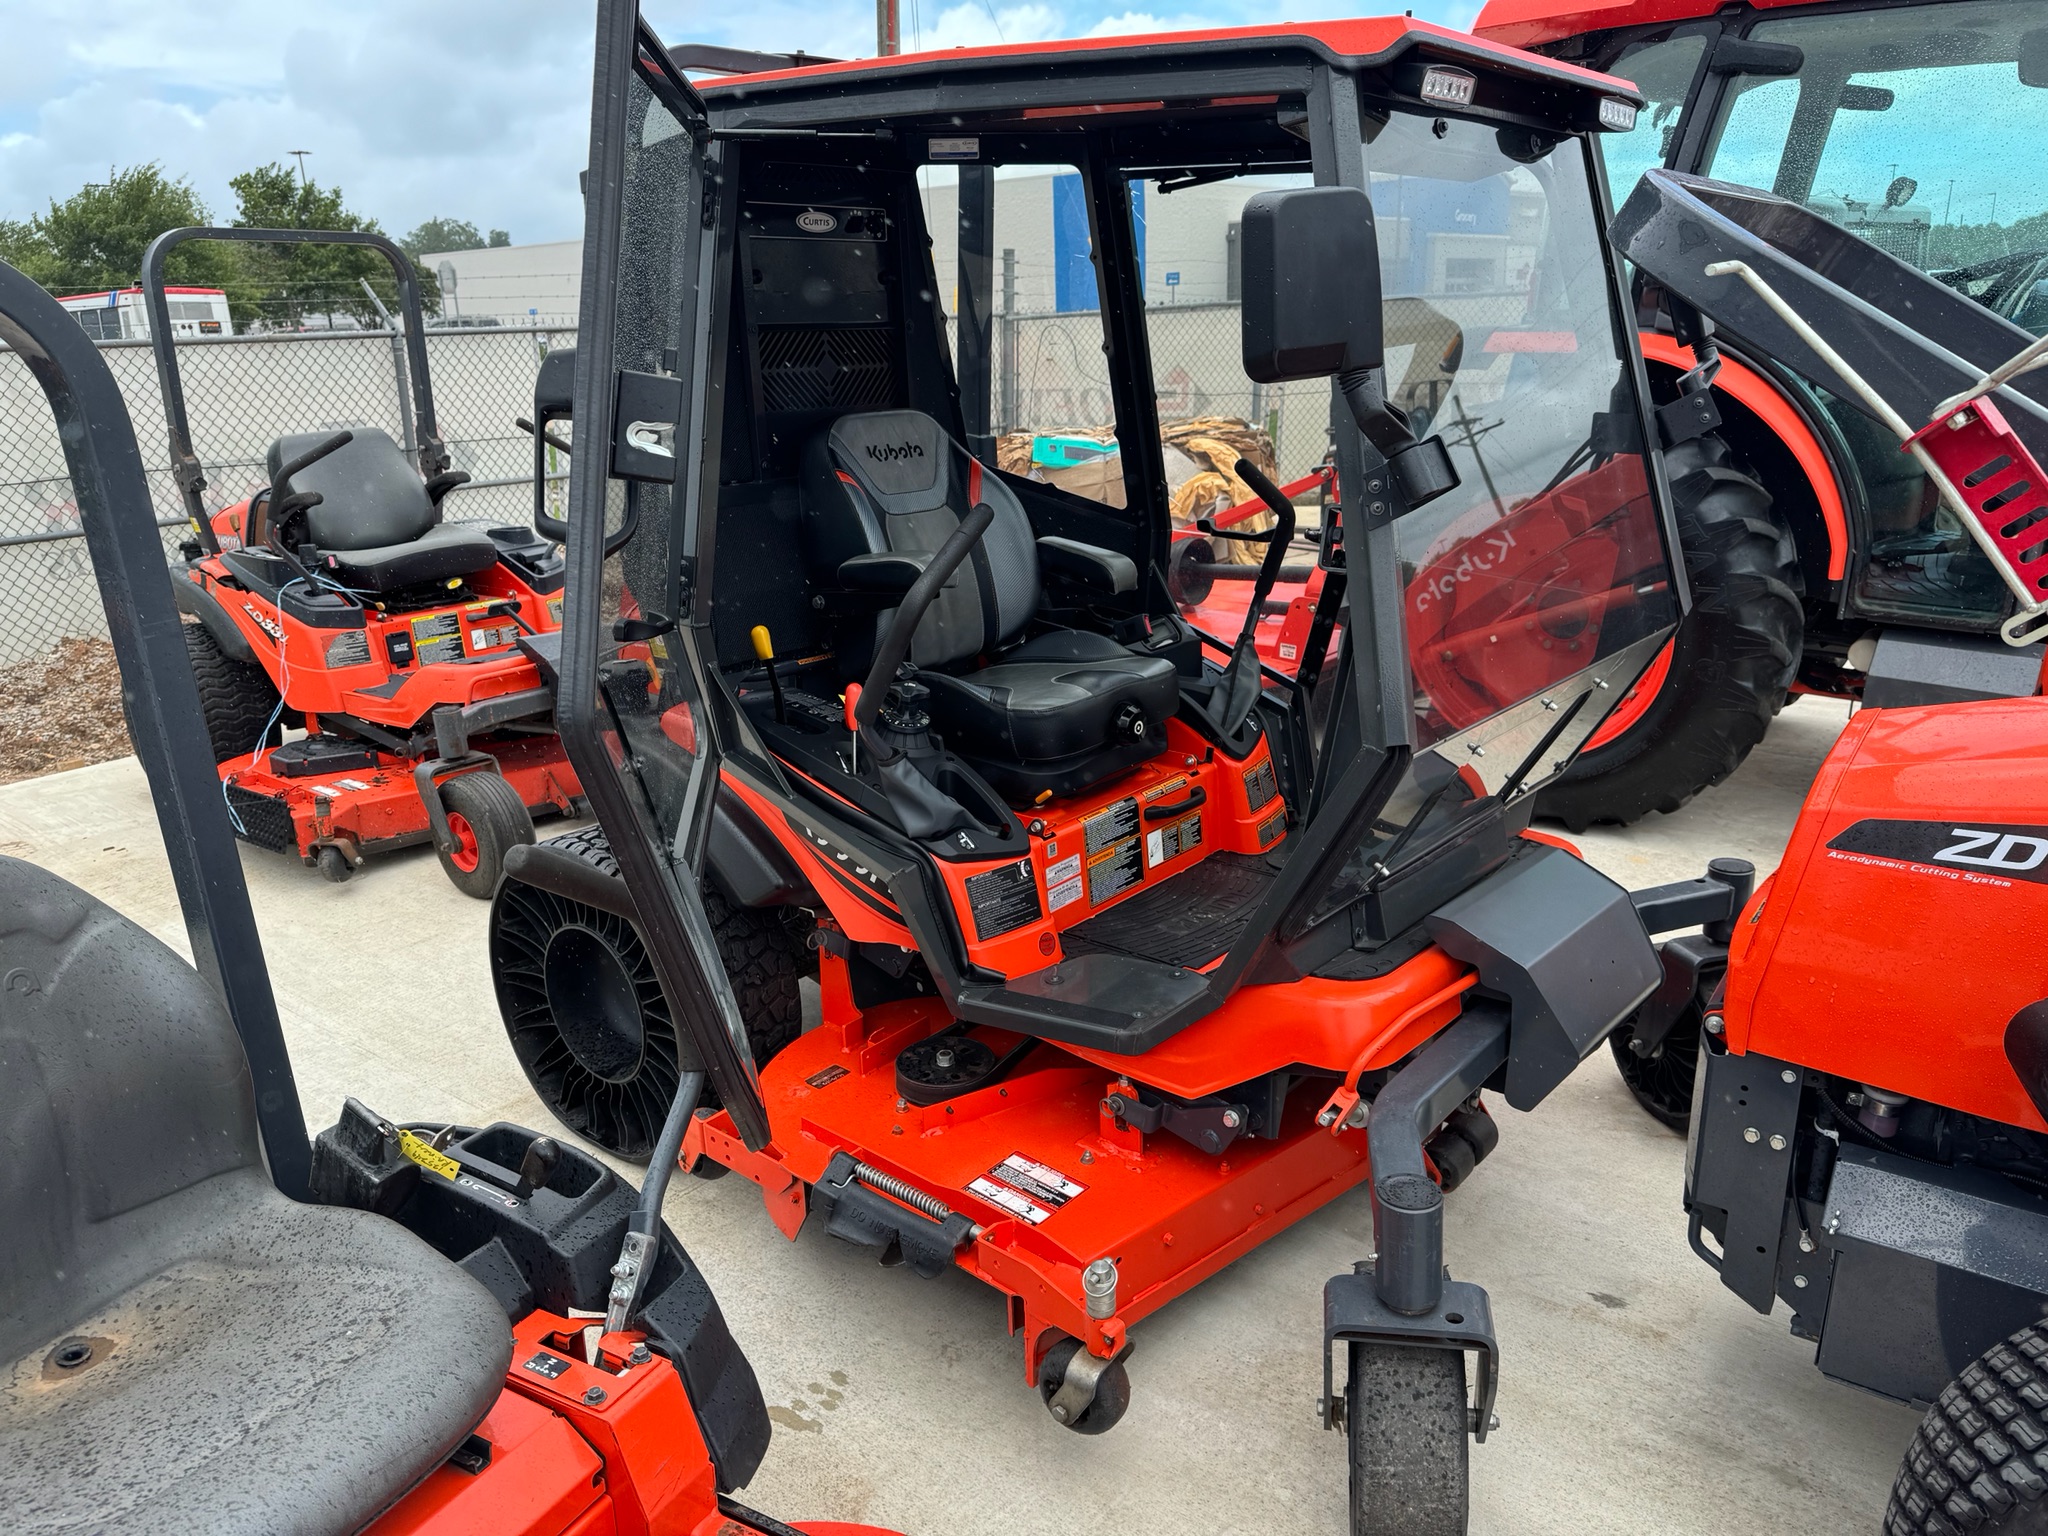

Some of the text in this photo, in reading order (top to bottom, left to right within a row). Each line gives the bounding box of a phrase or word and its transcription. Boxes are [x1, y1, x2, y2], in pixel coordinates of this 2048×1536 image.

[803, 216, 830, 228] CURTIS
[866, 441, 924, 462] Kubota
[1932, 828, 2048, 871] ZD
[1827, 851, 2012, 888] Aerodynamic Cutting System
